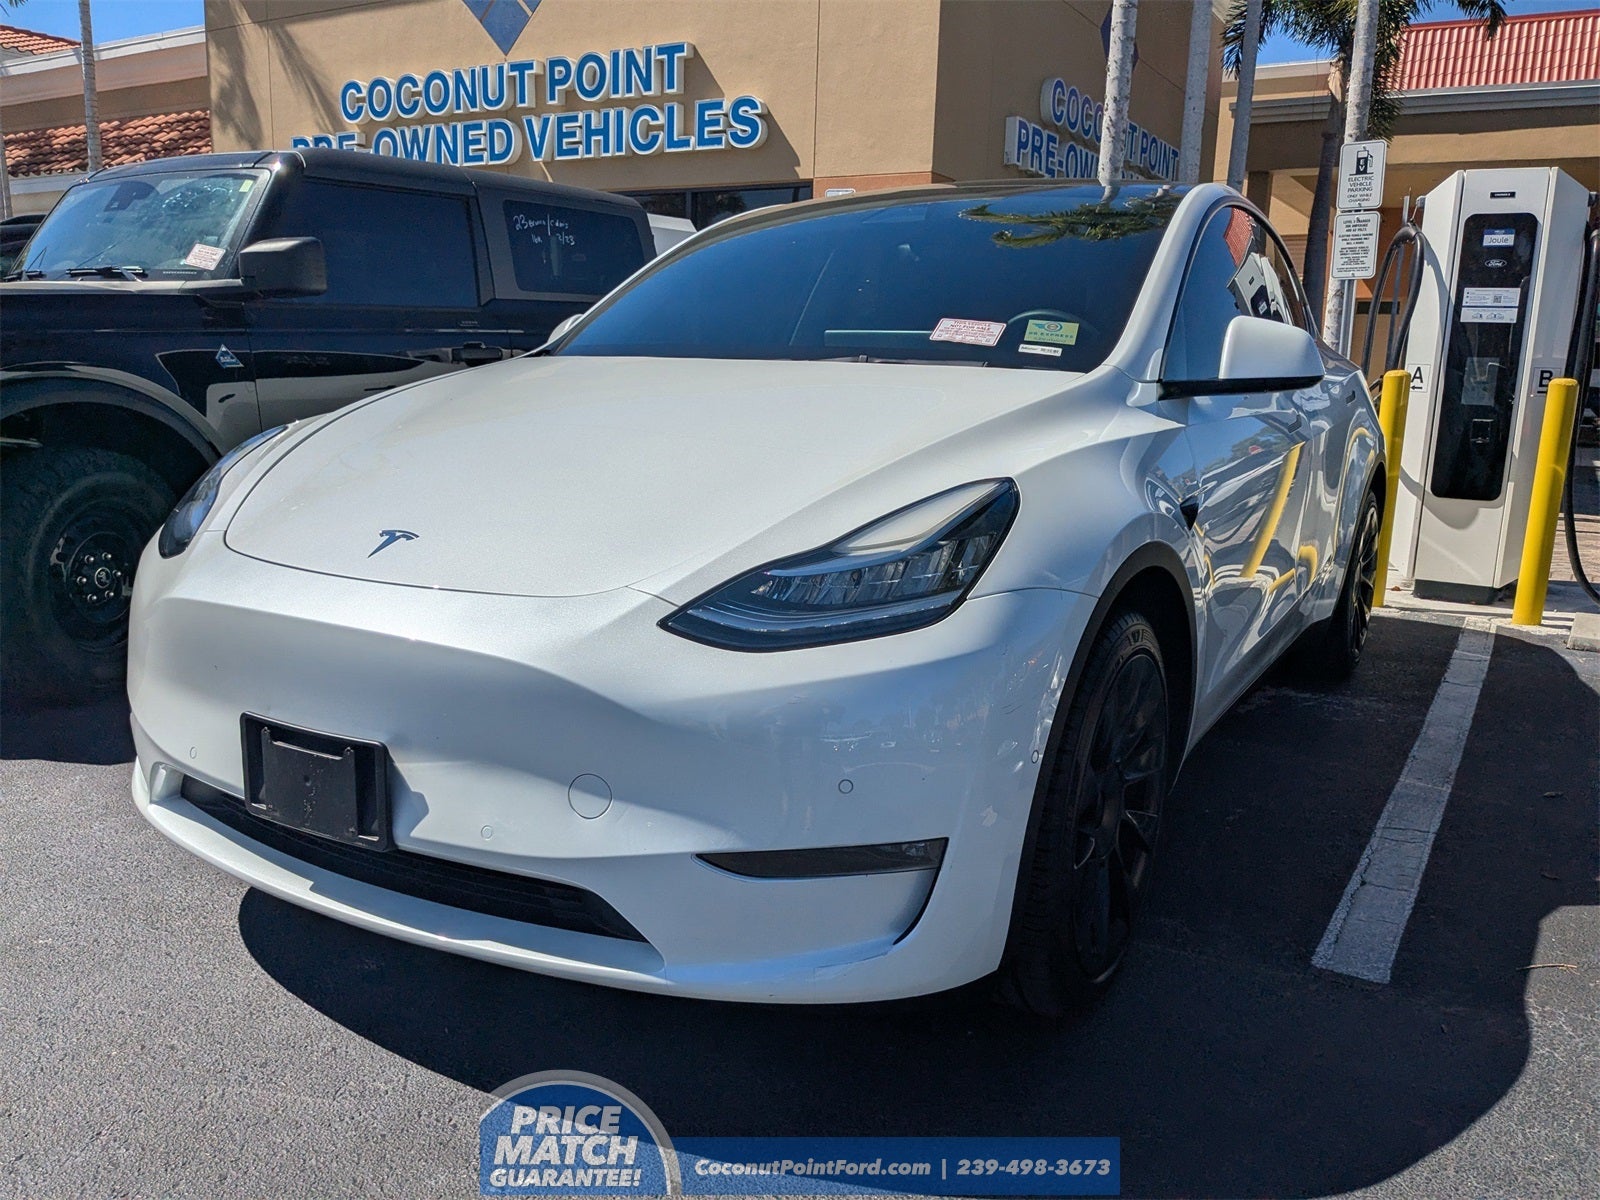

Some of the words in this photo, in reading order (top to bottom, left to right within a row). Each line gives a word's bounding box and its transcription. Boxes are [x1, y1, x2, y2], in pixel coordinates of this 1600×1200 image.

[340, 60, 538, 123] COCONUT
[546, 42, 690, 104] POINT
[524, 96, 765, 162] VEHICLES
[1488, 236, 1509, 244] Joule
[1411, 366, 1424, 383] A
[1538, 370, 1553, 387] B
